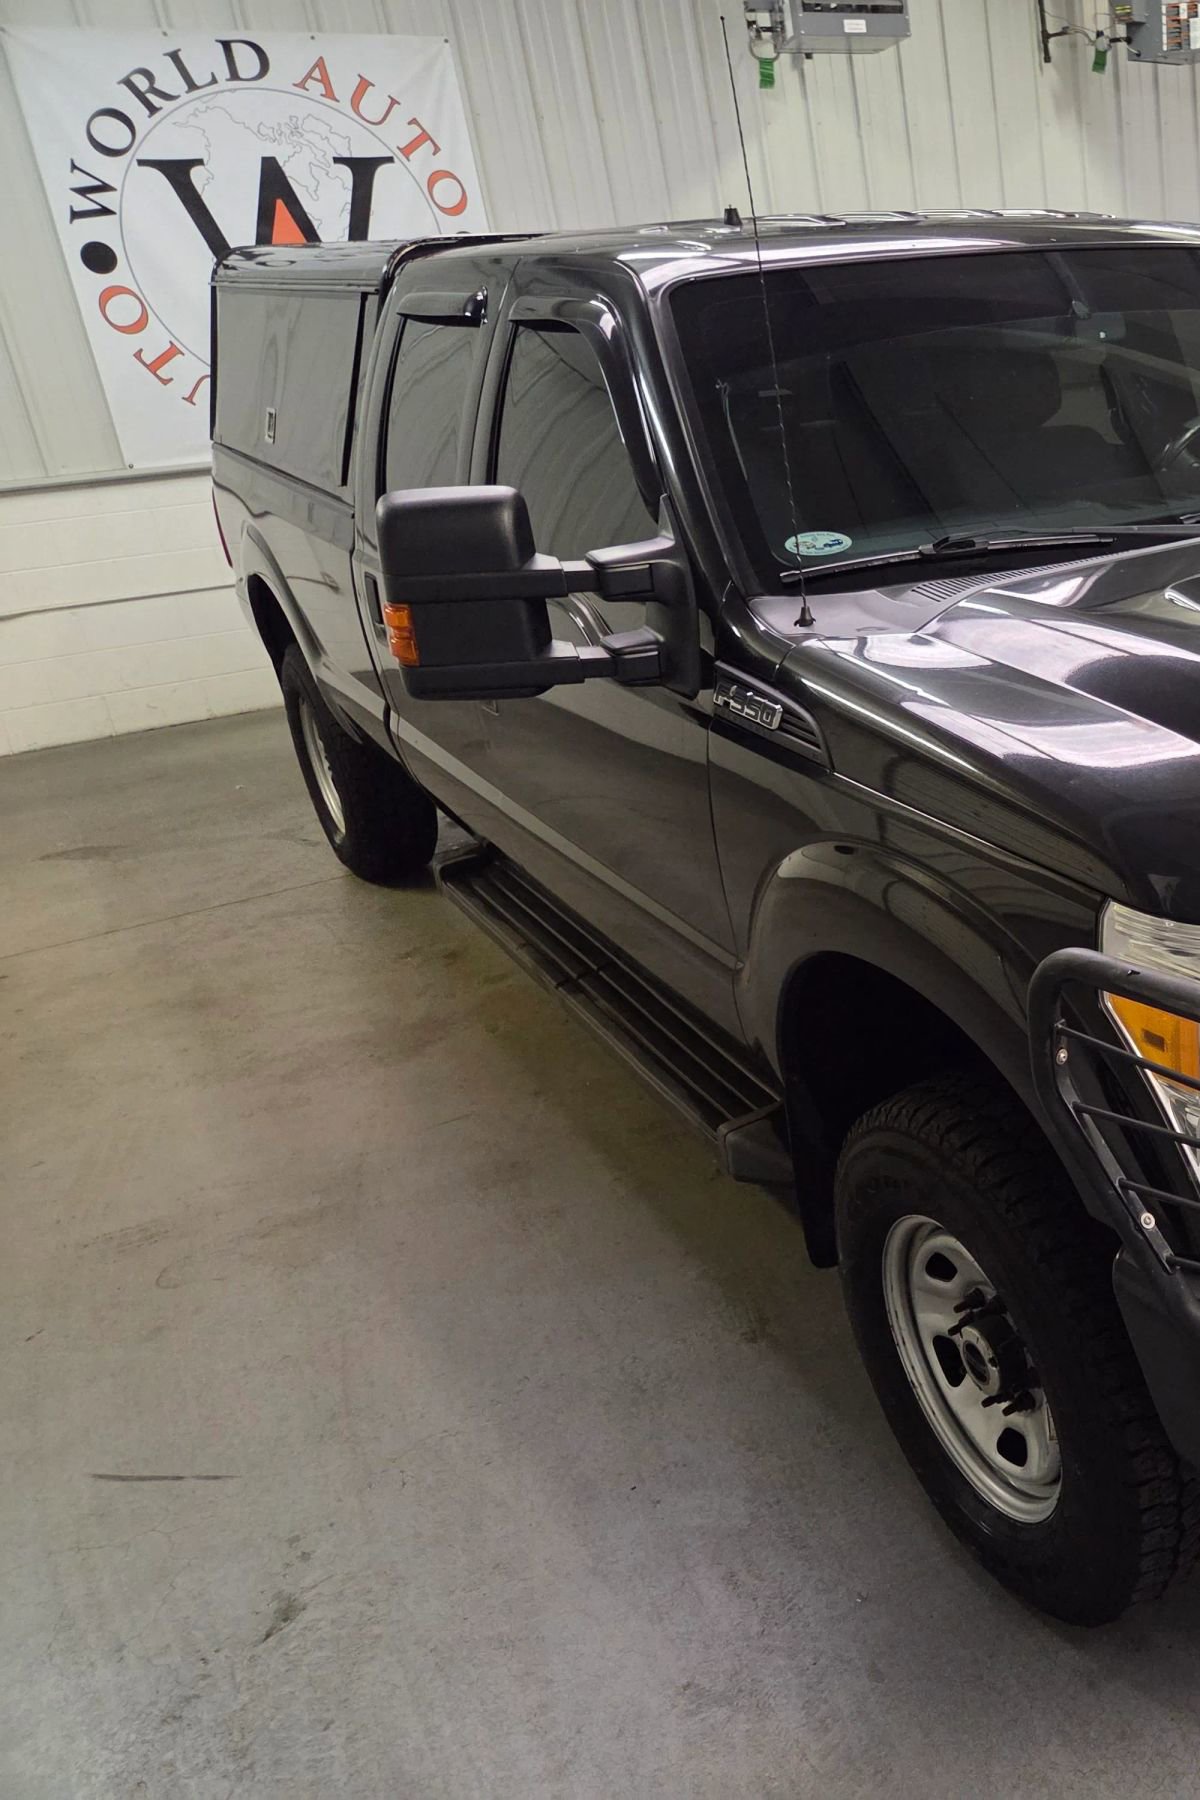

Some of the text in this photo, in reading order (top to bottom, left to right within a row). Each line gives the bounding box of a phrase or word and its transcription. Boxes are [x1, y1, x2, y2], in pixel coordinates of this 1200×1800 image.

[69, 39, 468, 225] WORLD AUTO
[98, 285, 211, 406] TO
